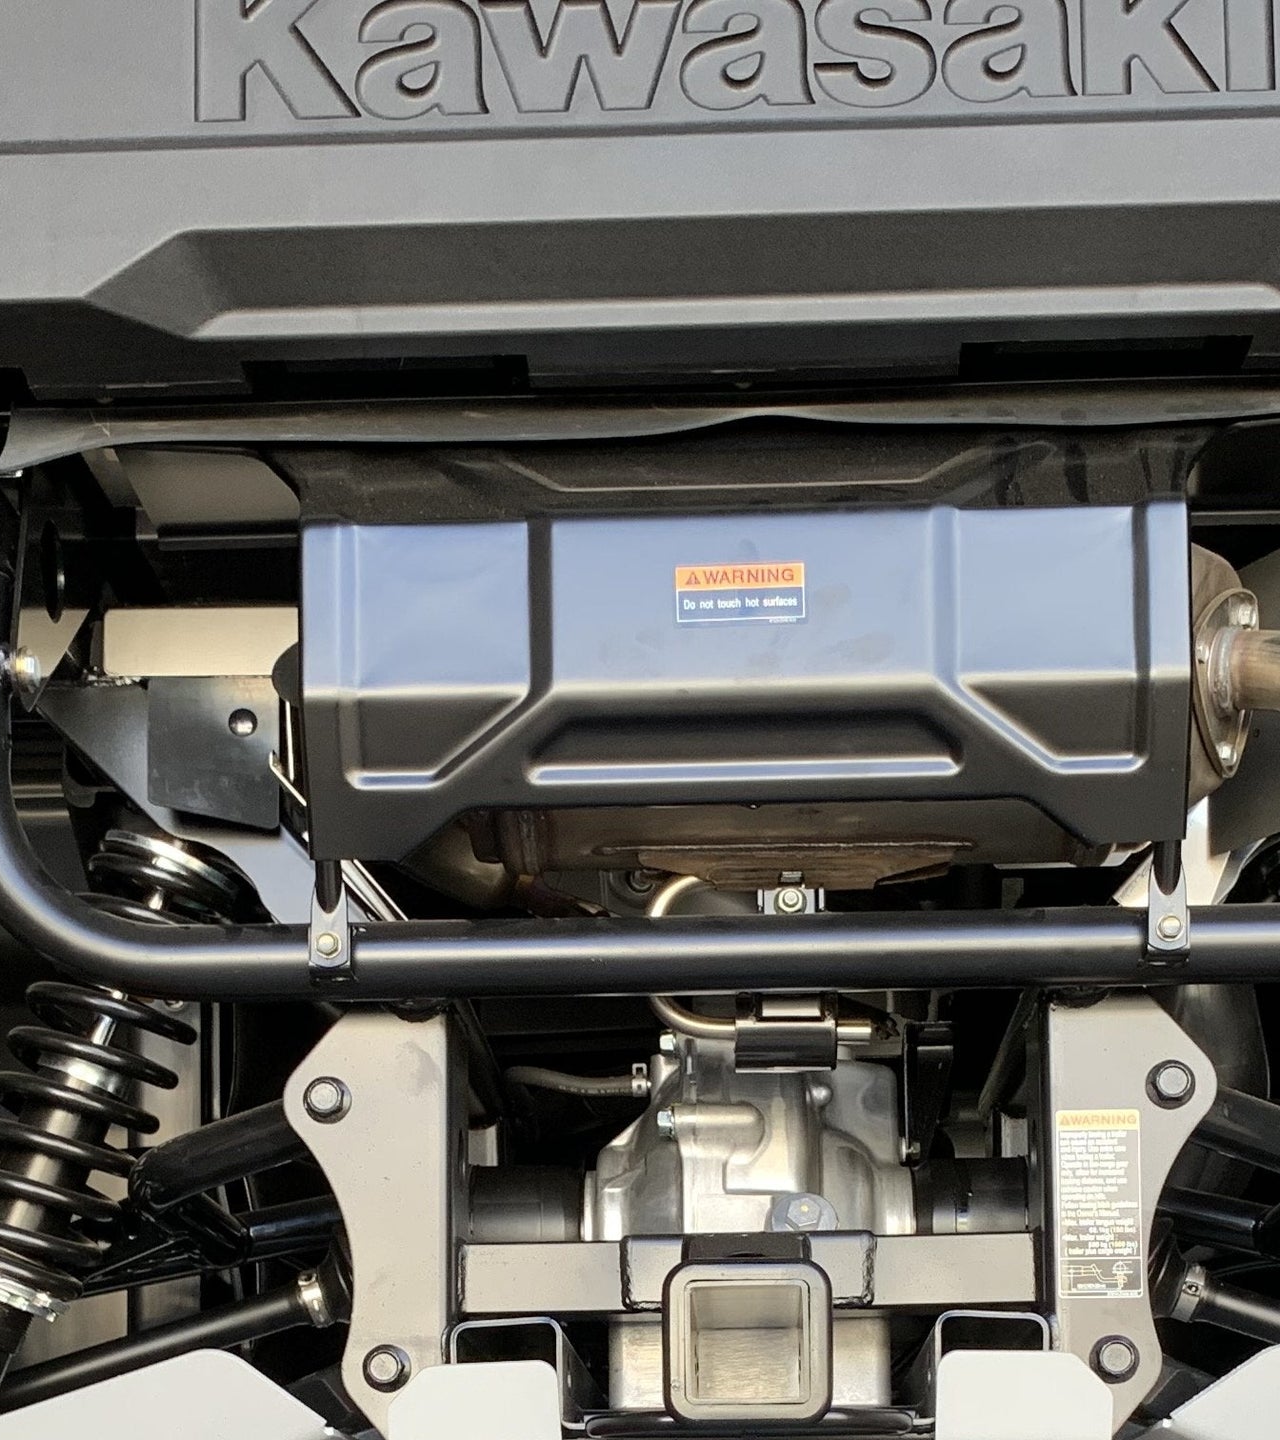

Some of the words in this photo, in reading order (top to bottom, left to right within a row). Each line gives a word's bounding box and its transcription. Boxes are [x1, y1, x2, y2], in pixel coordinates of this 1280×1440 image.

[194, 0, 1278, 123] Kawasaki
[703, 568, 794, 585] WARNING
[683, 598, 696, 610] Do
[699, 599, 714, 609] not
[717, 597, 741, 609] touch
[745, 596, 760, 608] hot
[763, 595, 798, 607] surfaces
[1069, 1114, 1137, 1126] WARNING
